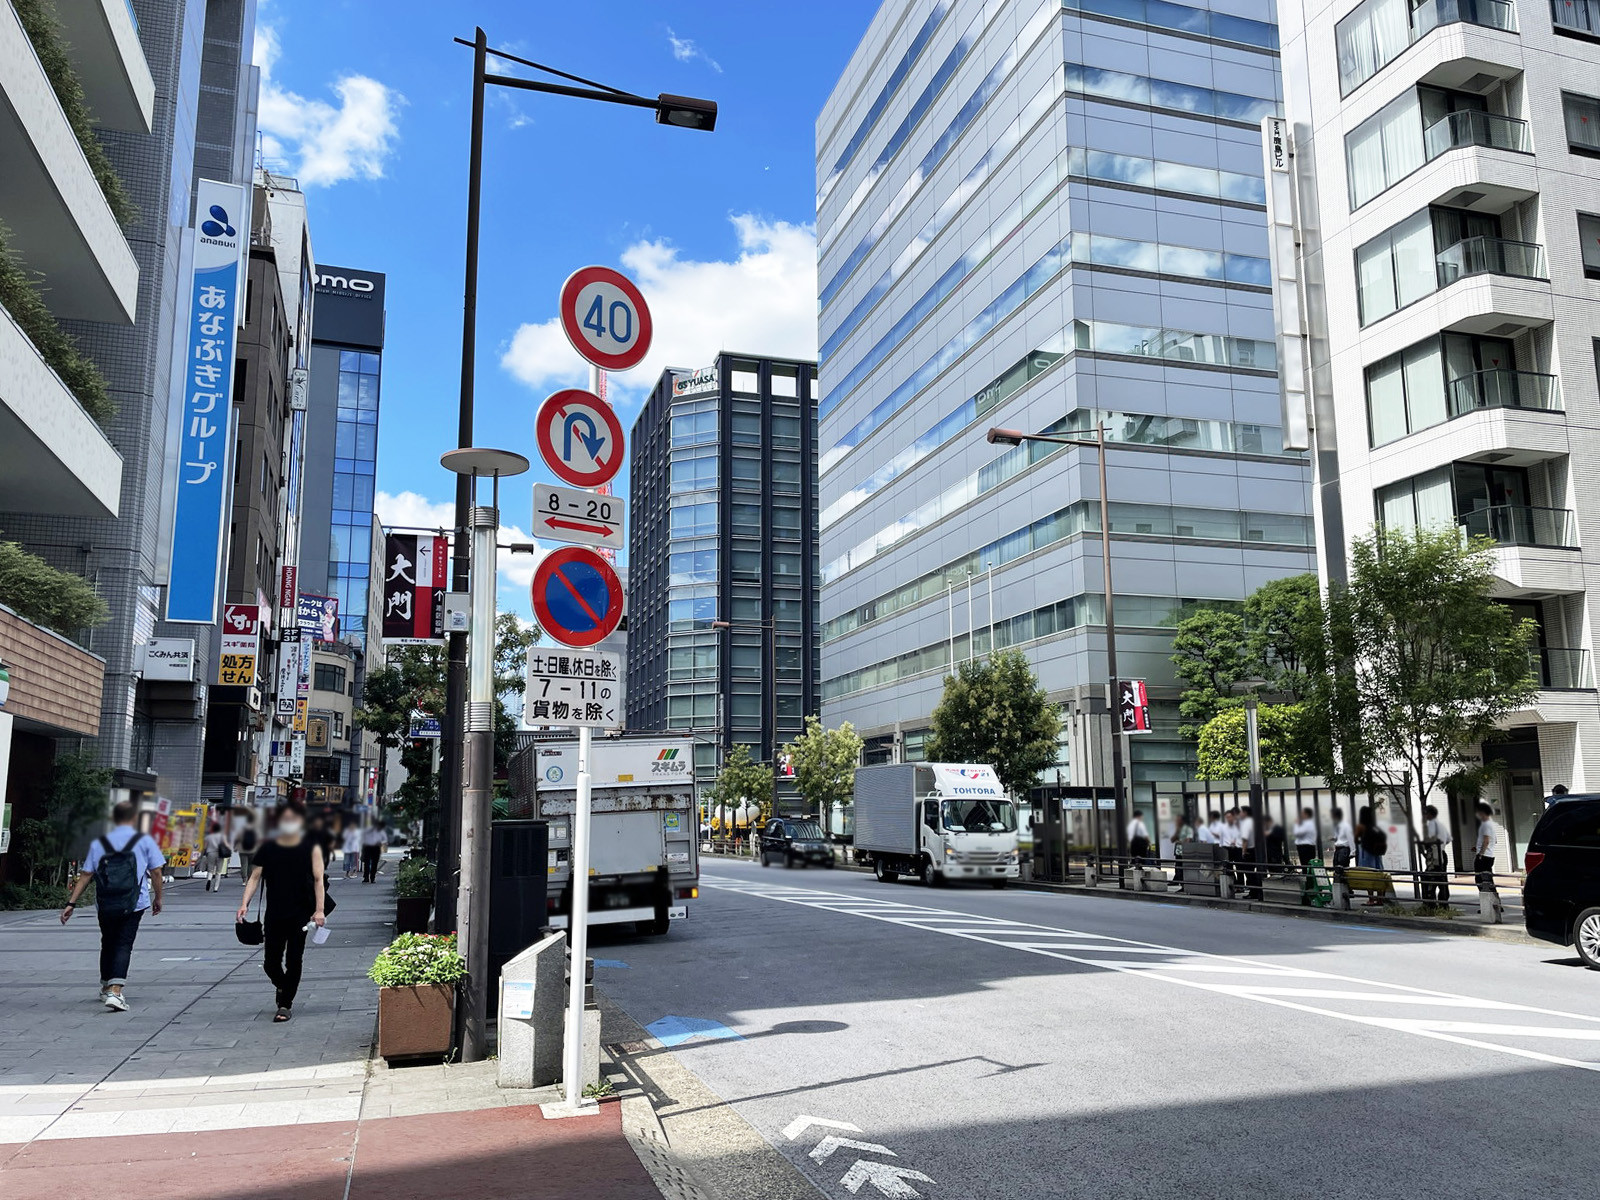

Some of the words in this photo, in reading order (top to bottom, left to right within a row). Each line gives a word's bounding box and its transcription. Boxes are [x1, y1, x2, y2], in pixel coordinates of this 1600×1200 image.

[583, 294, 632, 343] 40
[186, 285, 226, 485] あなぶきグループ
[688, 374, 715, 387] YUASA
[285, 567, 293, 589] HOANG
[385, 553, 416, 621] 大門
[284, 588, 292, 607] NGAN
[225, 606, 257, 634] くすり
[223, 641, 255, 649] スギ薬局
[148, 651, 189, 659] こくみん共済
[222, 654, 253, 669] 処方
[221, 670, 251, 684] せん
[532, 700, 615, 722] 貨物を除く
[1121, 690, 1135, 723] 大門
[651, 761, 686, 772] スギムラ
[953, 787, 996, 795] TOHTORA
